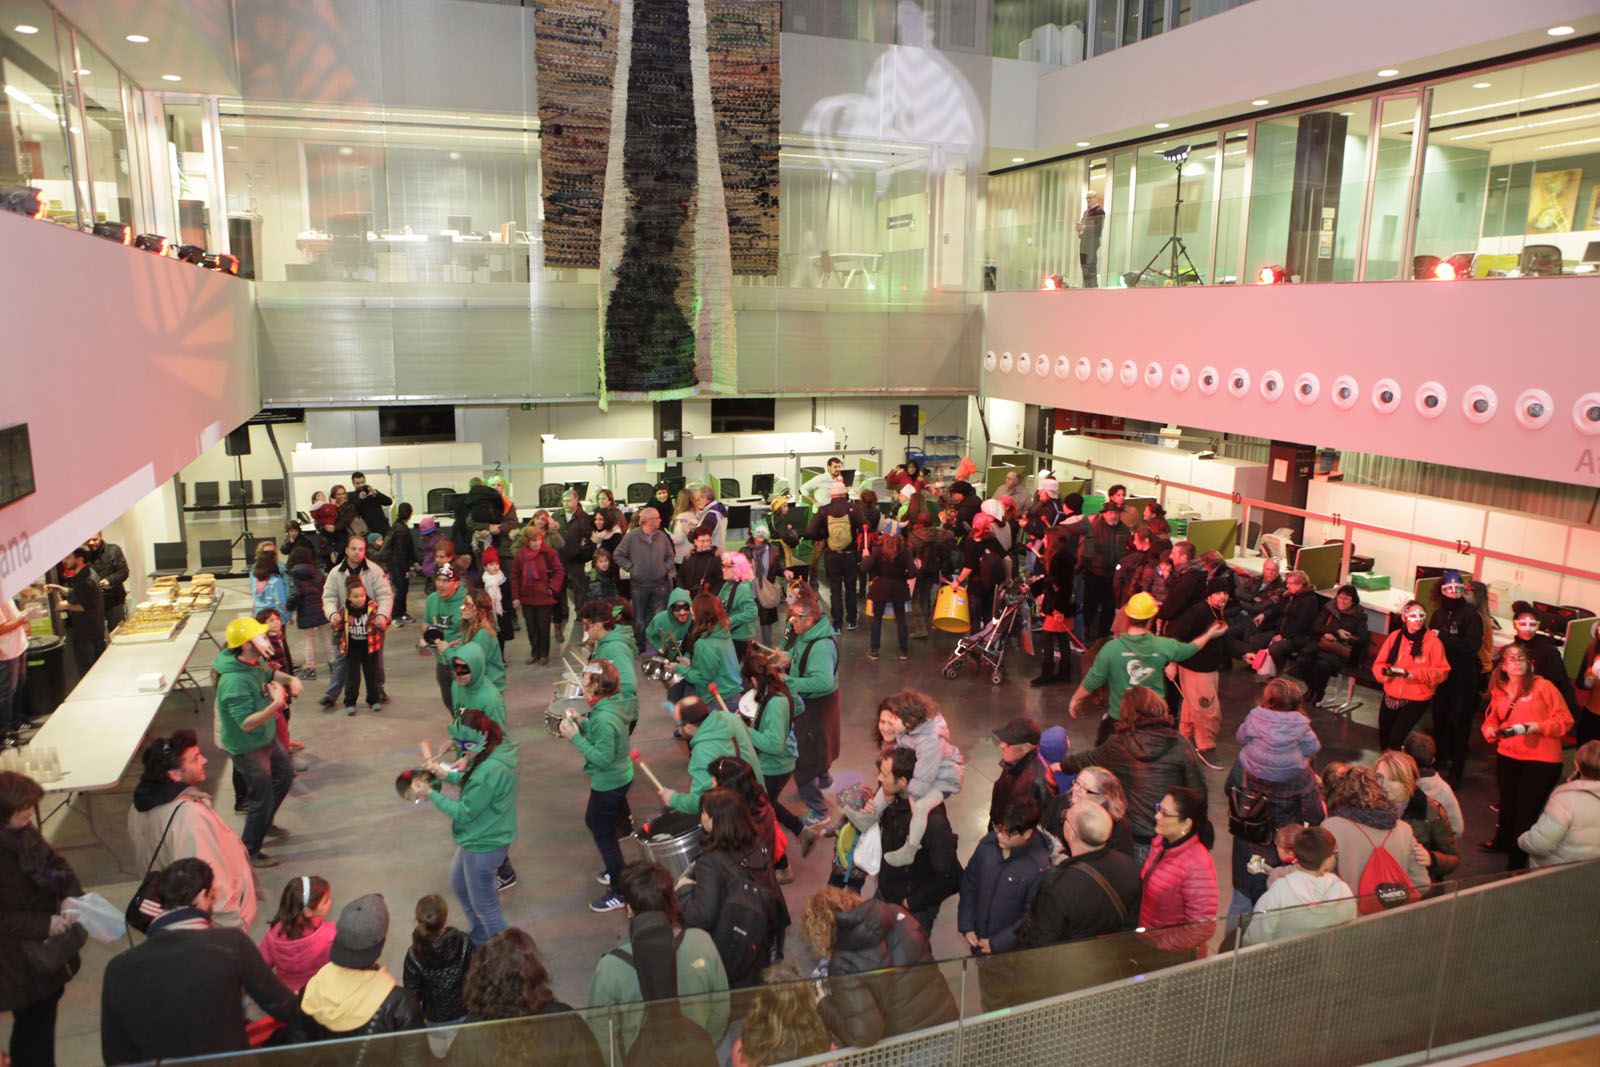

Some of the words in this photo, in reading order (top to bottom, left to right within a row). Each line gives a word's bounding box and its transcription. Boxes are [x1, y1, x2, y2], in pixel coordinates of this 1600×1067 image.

[788, 449, 796, 460] 5
[869, 446, 876, 456] 6
[597, 456, 604, 467] 3
[695, 453, 704, 464] 4
[494, 460, 502, 472] 2
[1154, 475, 1160, 486] 9
[1232, 491, 1242, 504] 10
[1331, 513, 1341, 526] 11
[1456, 540, 1471, 555] 12
[349, 626, 368, 636] GIRL
